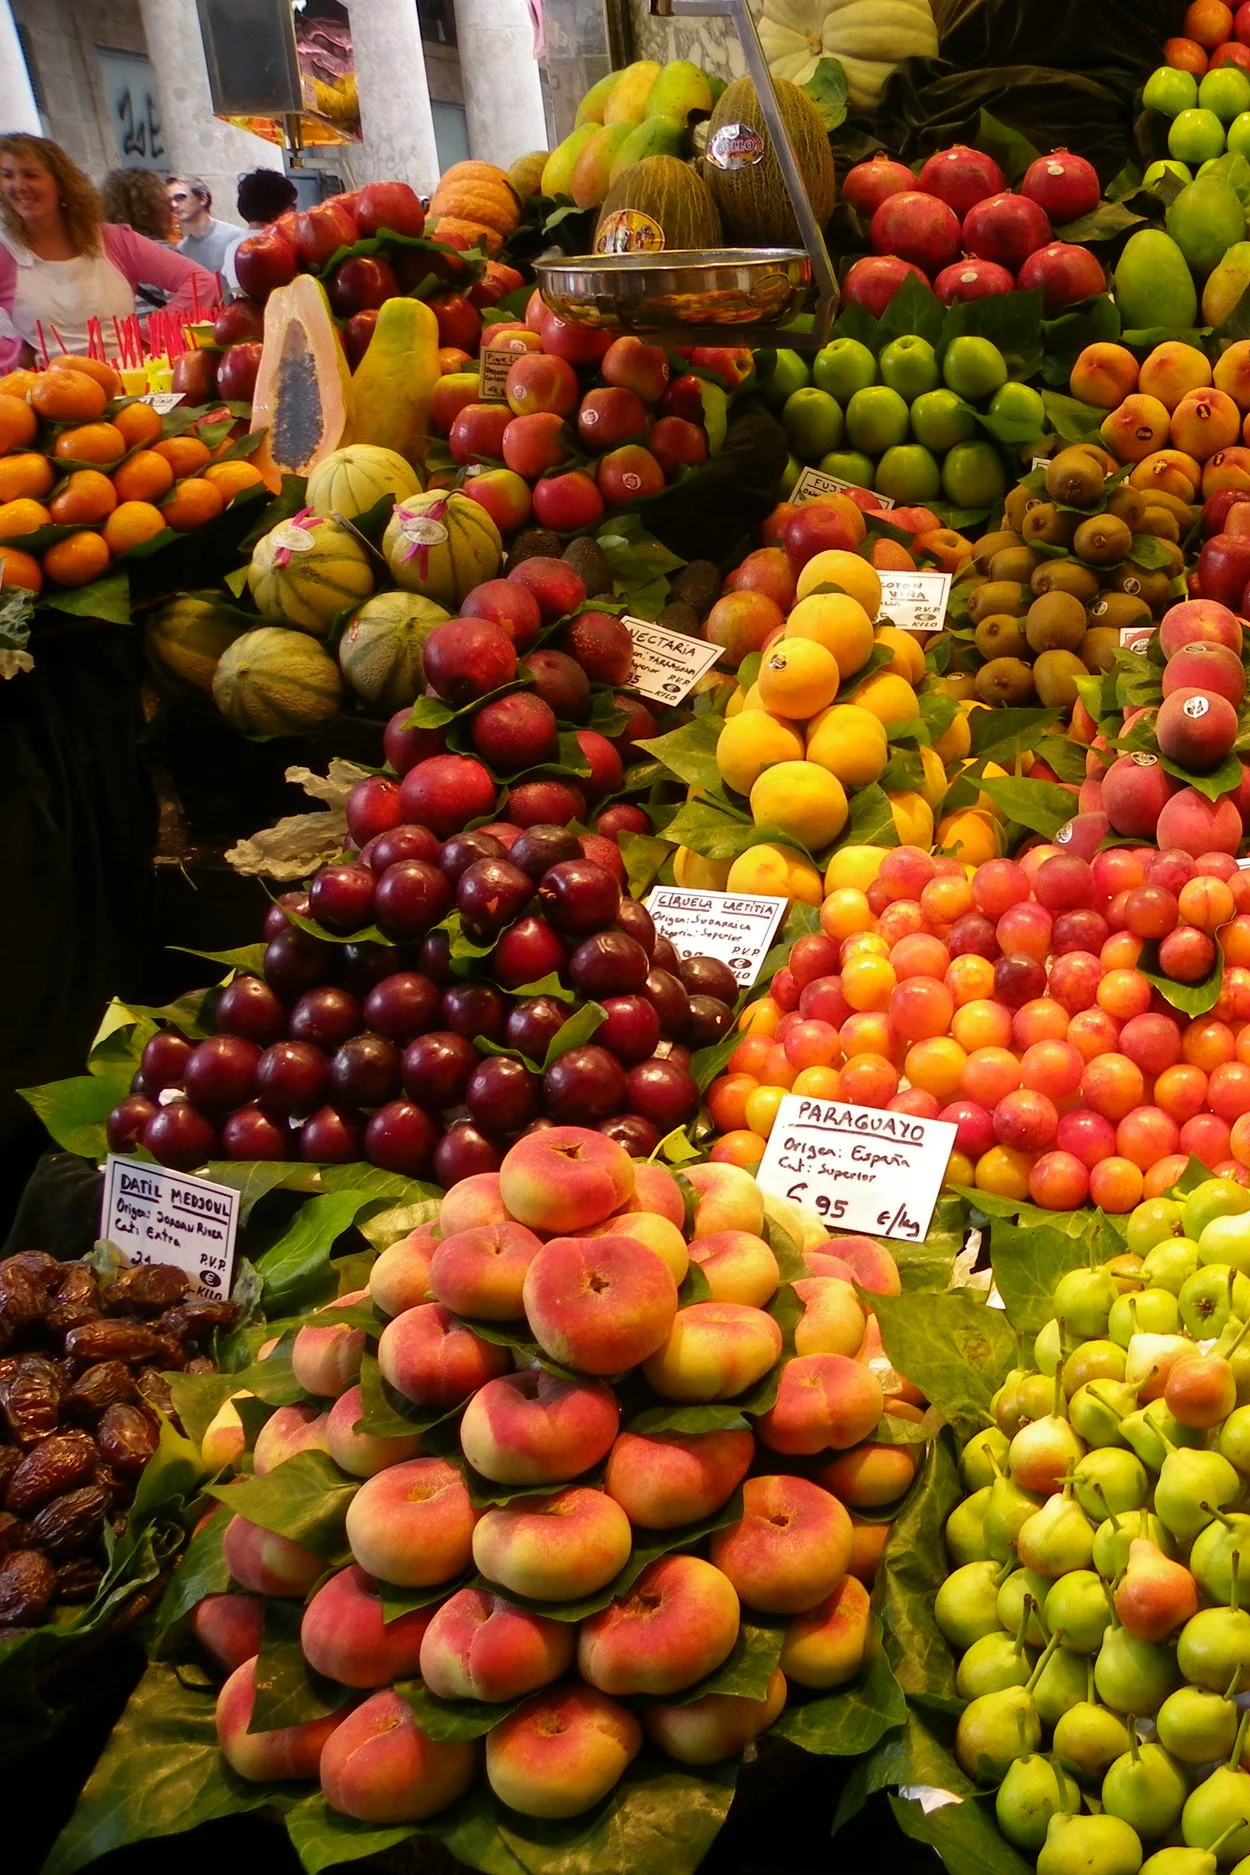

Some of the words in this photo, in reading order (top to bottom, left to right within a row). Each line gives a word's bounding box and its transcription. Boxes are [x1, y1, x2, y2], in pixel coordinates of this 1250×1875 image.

[654, 690, 678, 701] KILO
[658, 893, 713, 910] CIRUELA
[798, 1101, 925, 1141] PARAGUAYO
[784, 1137, 842, 1160] Origen:
[851, 1145, 911, 1168] España
